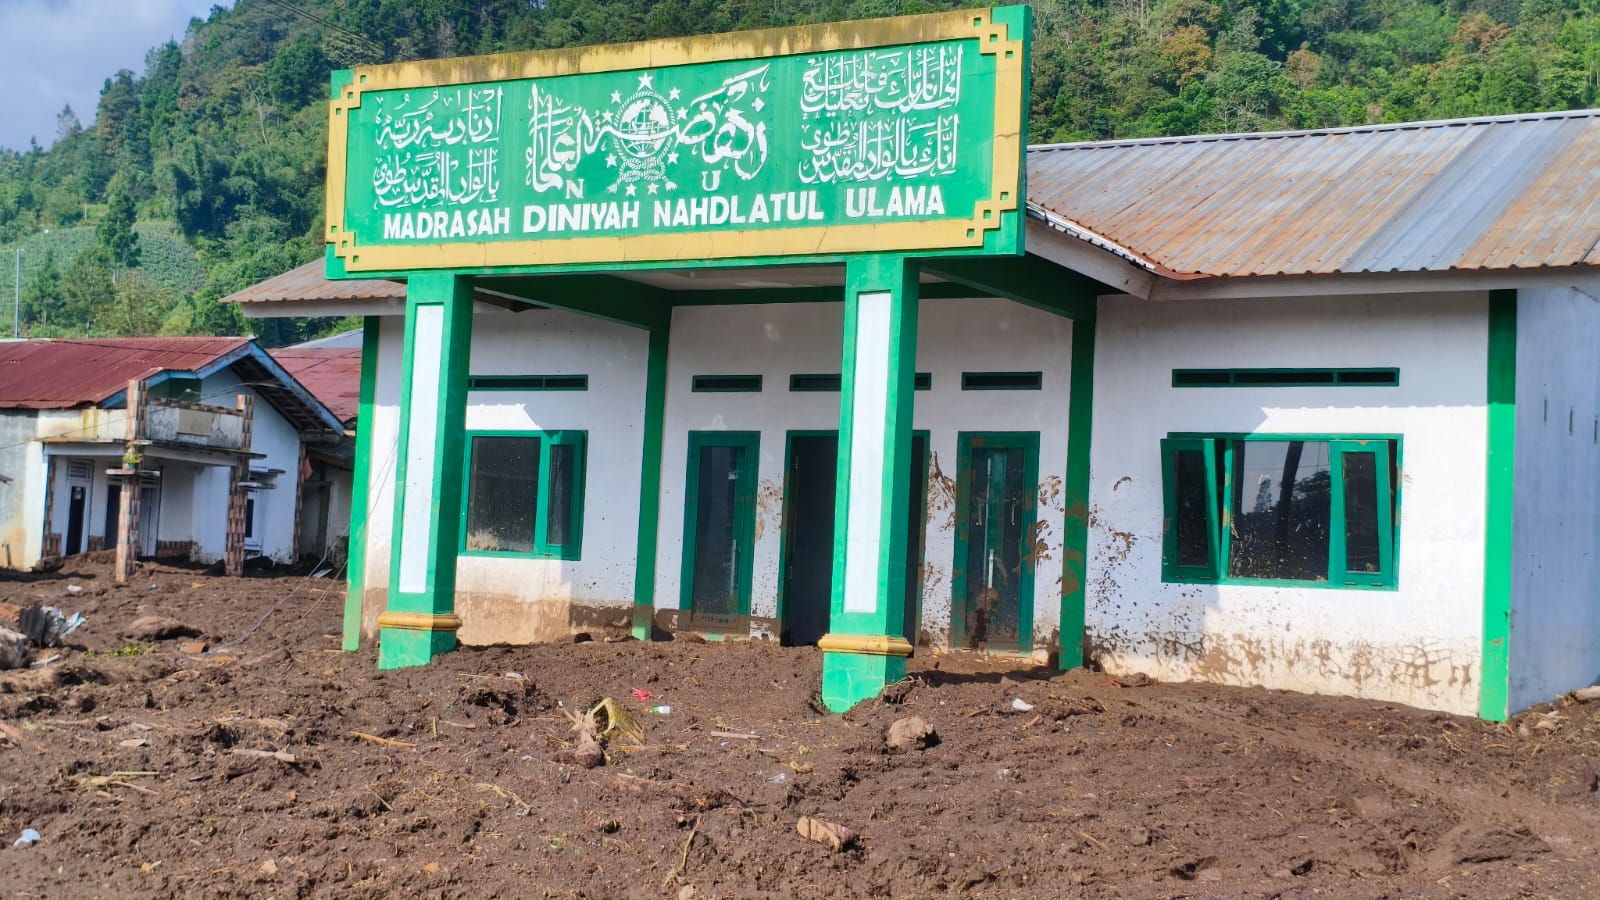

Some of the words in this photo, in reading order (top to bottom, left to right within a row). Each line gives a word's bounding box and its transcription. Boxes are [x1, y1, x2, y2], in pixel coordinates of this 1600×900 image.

[565, 179, 584, 199] N
[701, 170, 721, 191] U
[383, 207, 511, 240] MADRASAH
[523, 201, 640, 233] DINIYAH
[653, 191, 824, 229] NAHDLATUL
[845, 185, 946, 217] ULAMA
